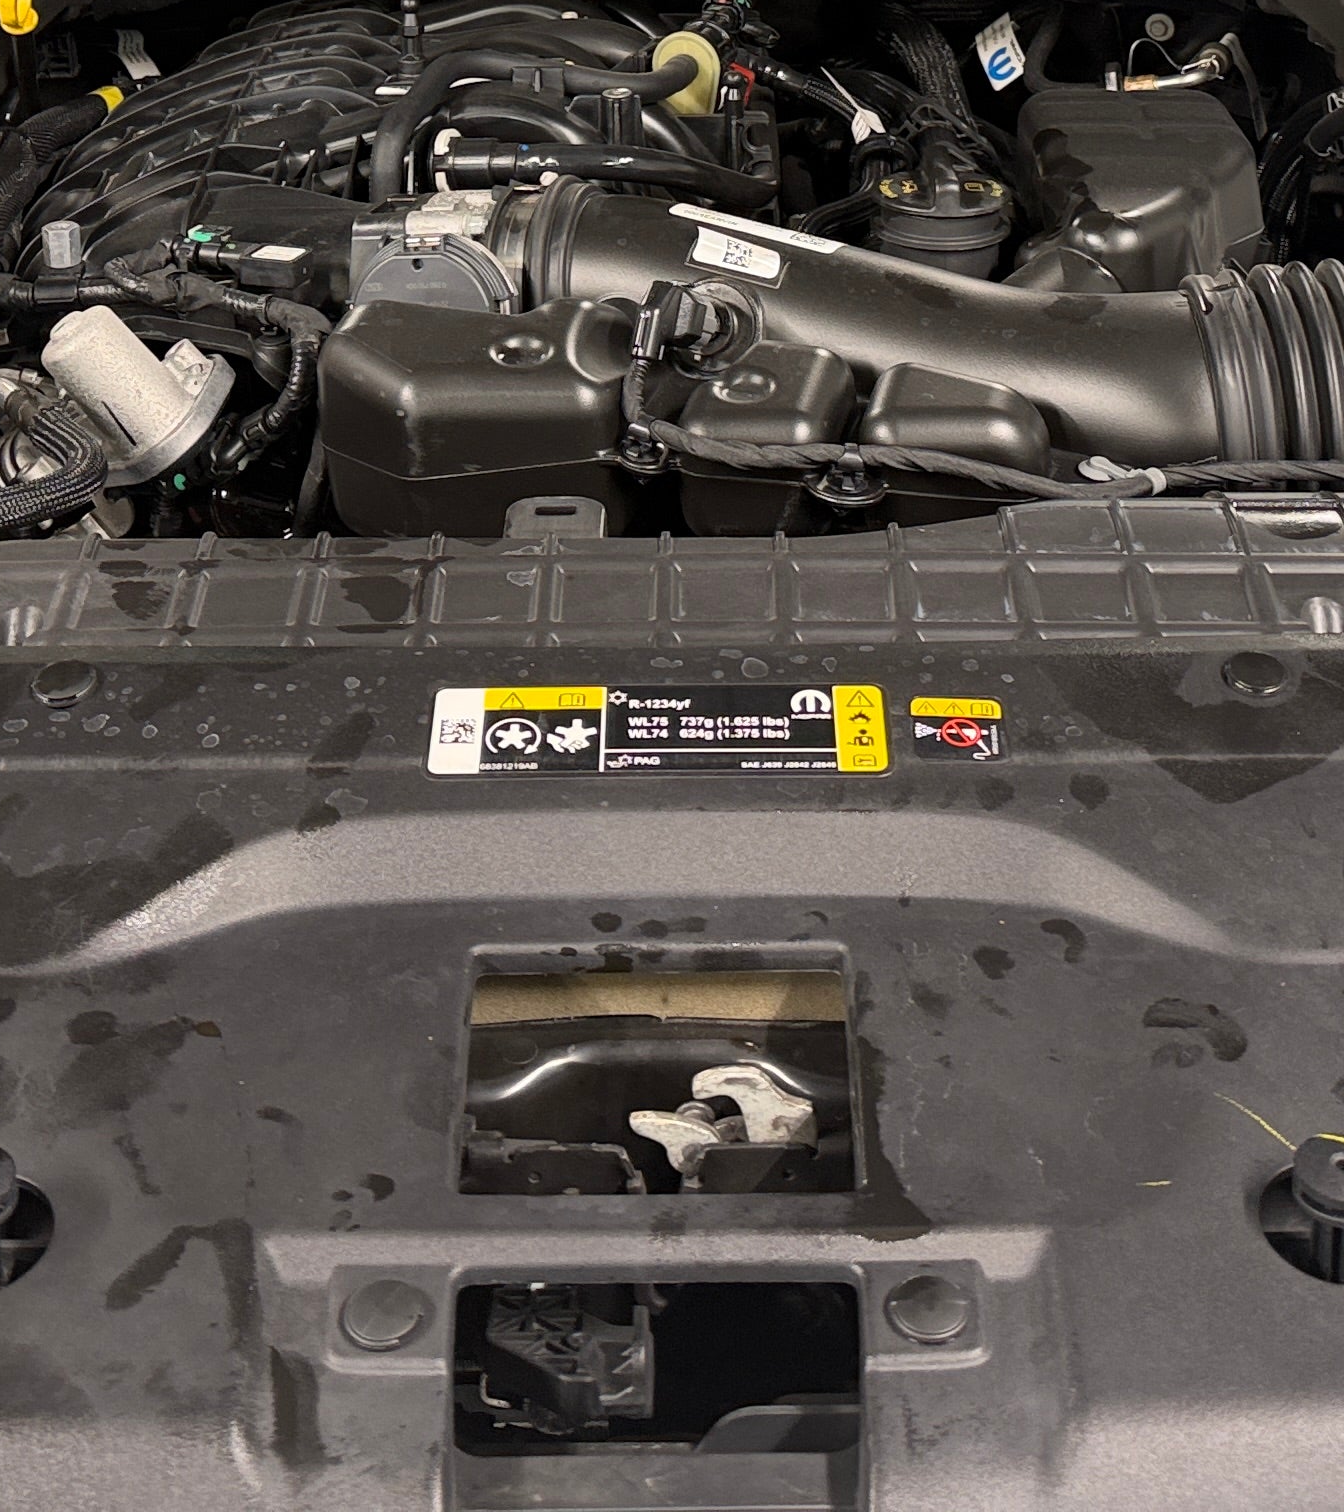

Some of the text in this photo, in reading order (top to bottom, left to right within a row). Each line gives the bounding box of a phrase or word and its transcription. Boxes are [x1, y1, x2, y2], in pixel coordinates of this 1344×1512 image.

[628, 699, 692, 711] R-1234yf
[627, 716, 790, 728] WL75 737g (1.625 lbs)
[627, 728, 791, 740] WL74 624g (1.375 lbs)
[633, 756, 661, 766] PAG
[741, 761, 760, 769] SAE
